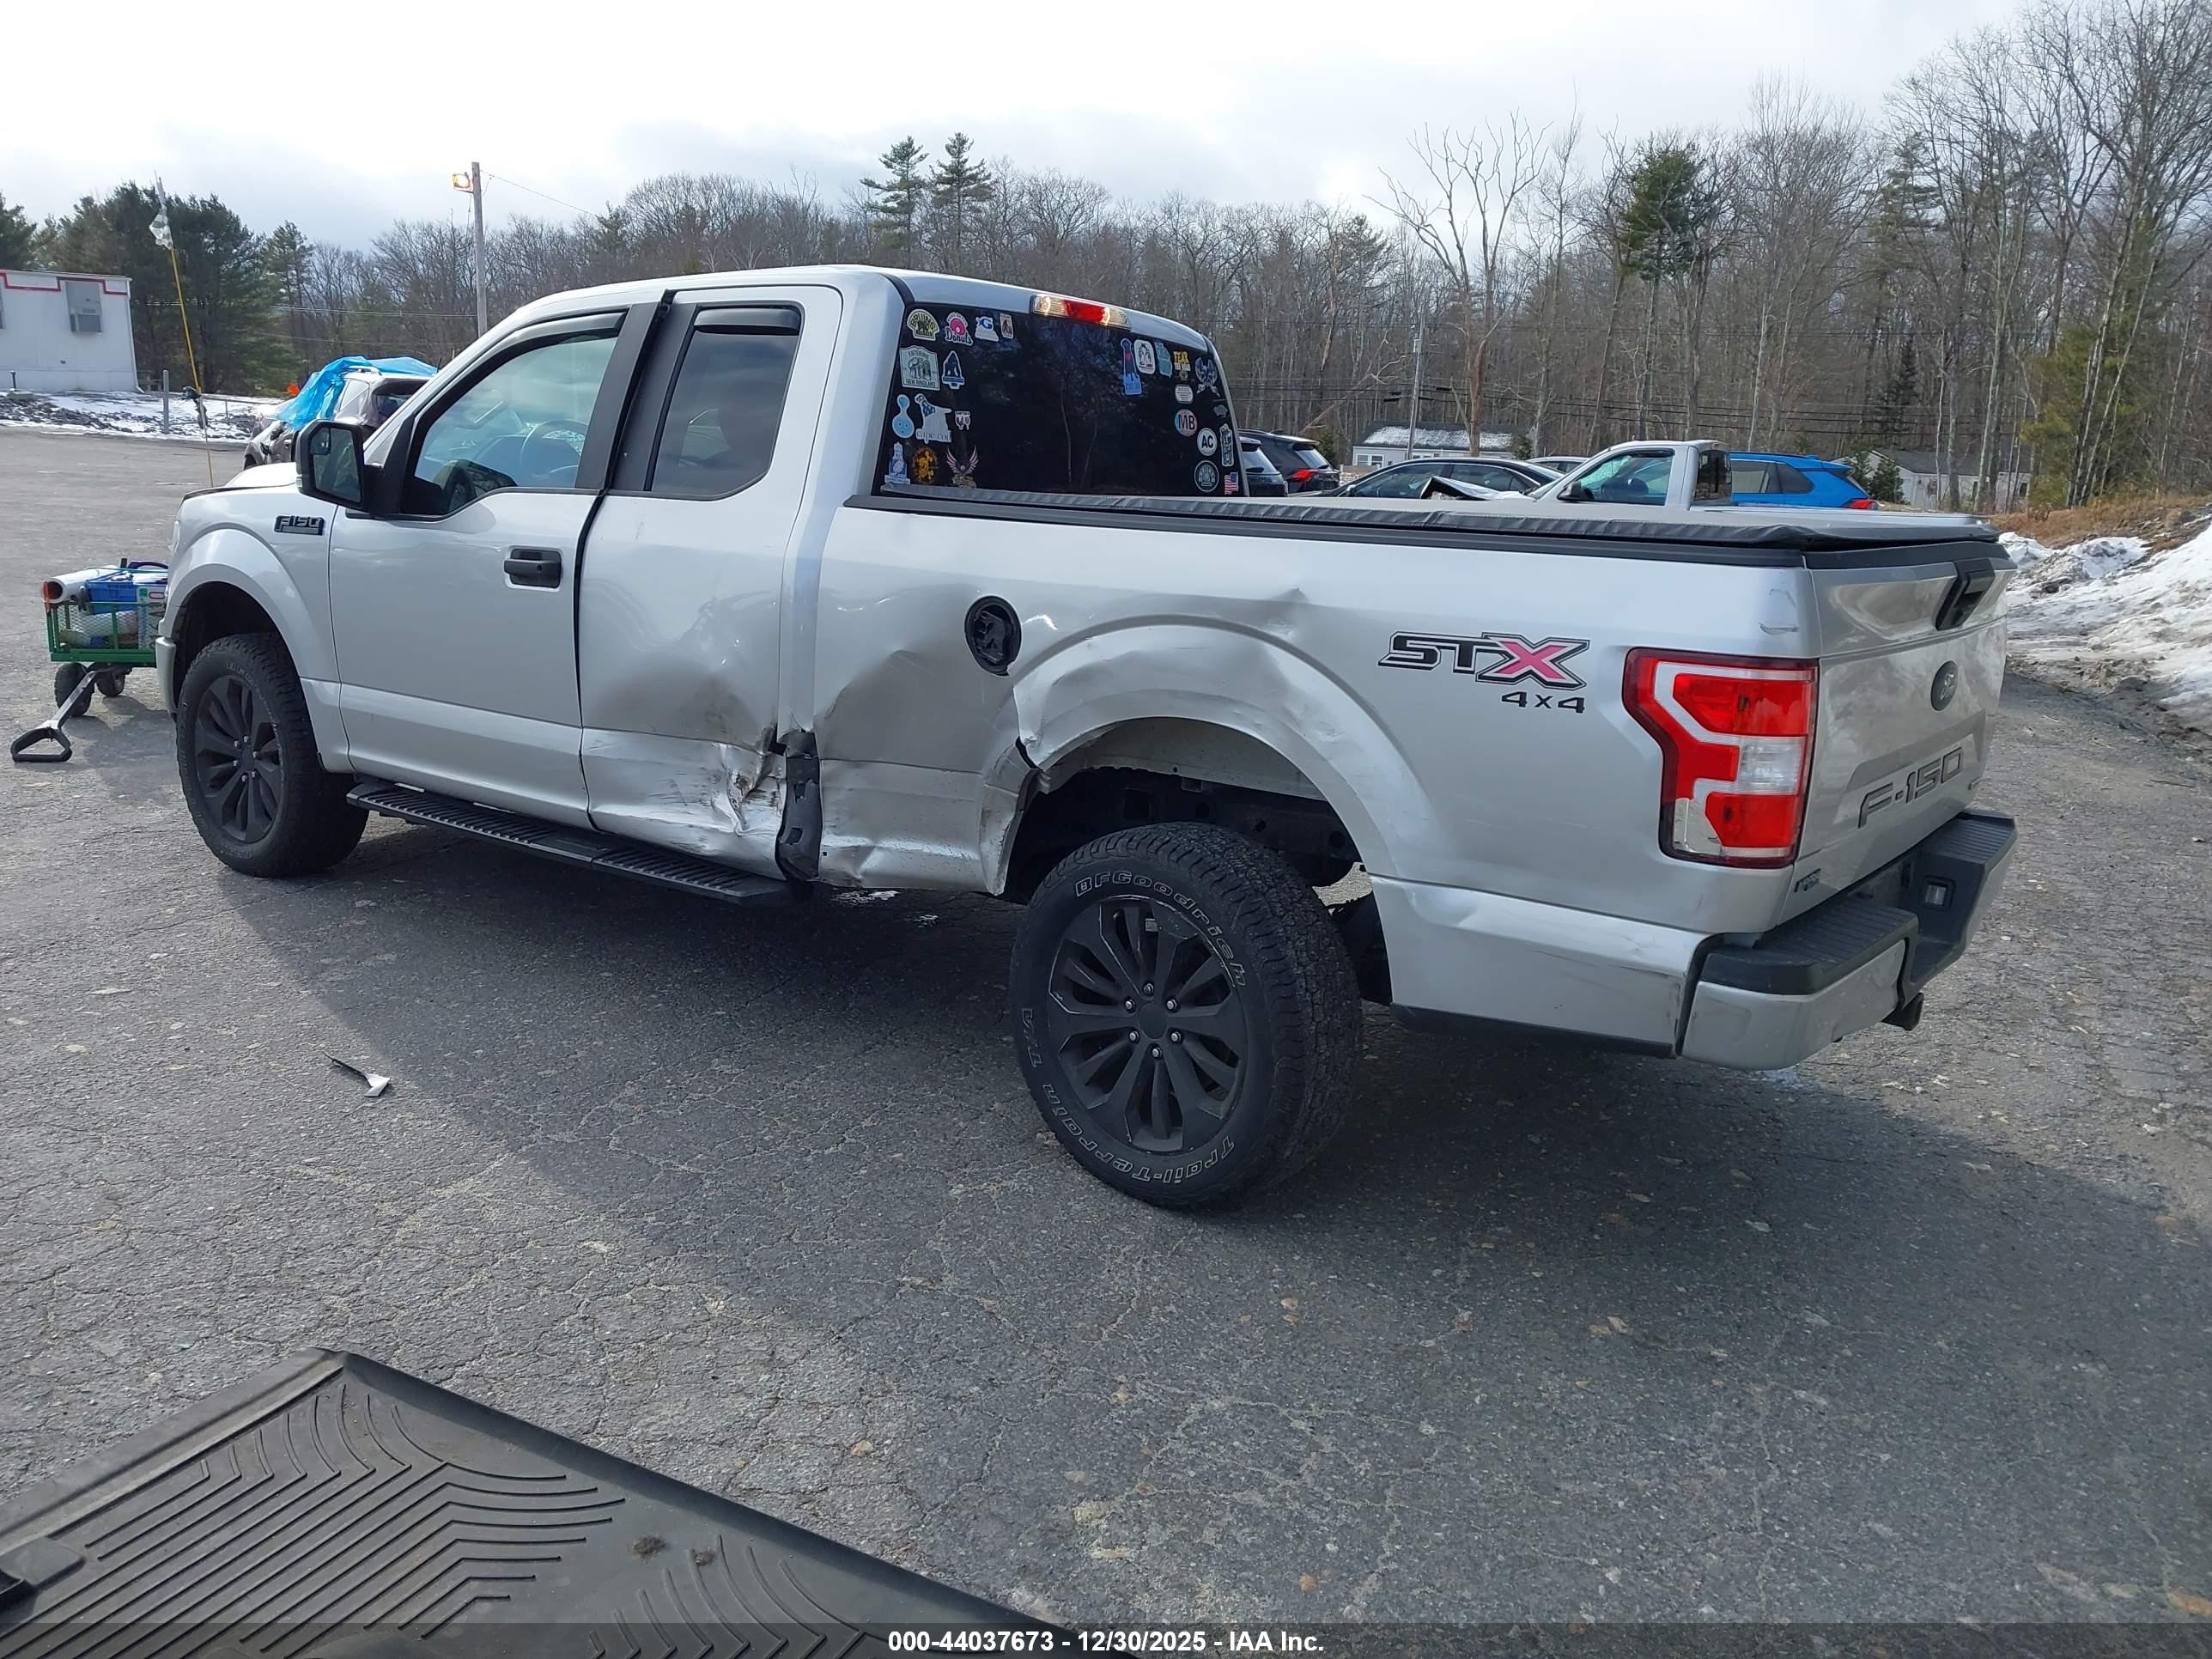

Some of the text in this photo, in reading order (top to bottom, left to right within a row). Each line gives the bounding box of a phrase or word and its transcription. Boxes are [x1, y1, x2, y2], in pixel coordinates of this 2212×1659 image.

[910, 313, 936, 331] BRUINS
[1178, 414, 1195, 430] MB
[1201, 434, 1214, 449] AC
[1377, 630, 1590, 690] STX
[1857, 745, 1965, 830] F-150
[1075, 870, 1247, 988] BFGoodrich
[1042, 1084, 1236, 1185] Trail-Terrain
